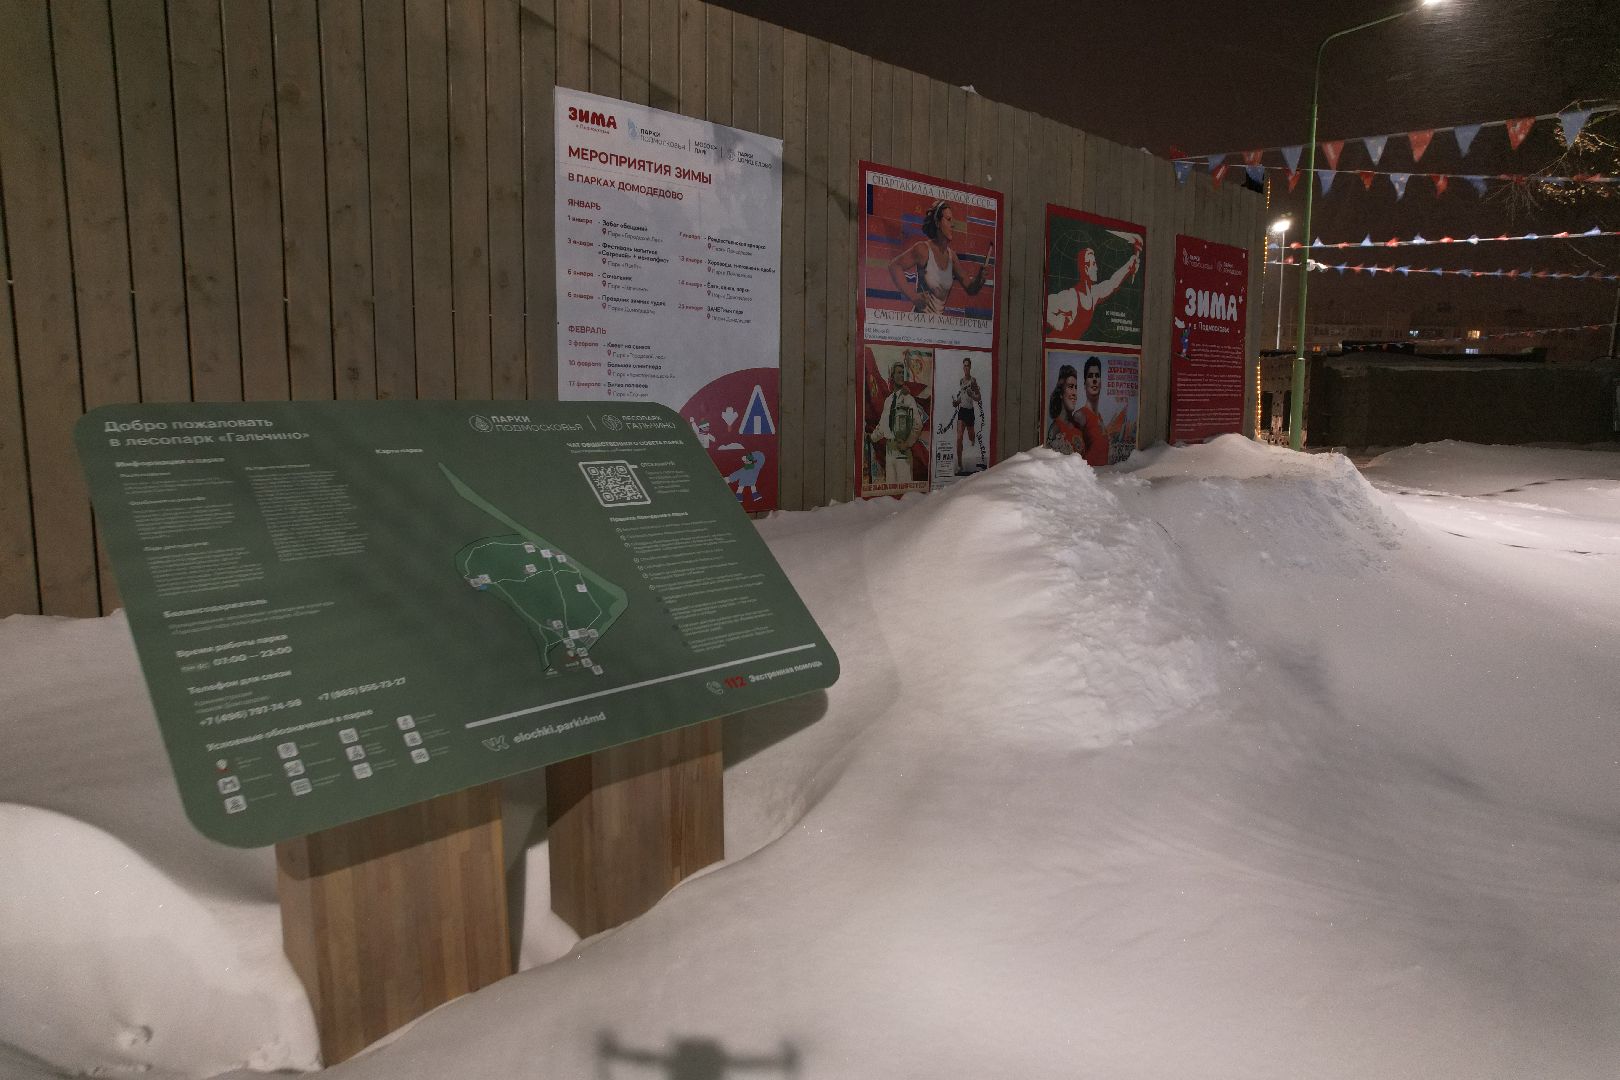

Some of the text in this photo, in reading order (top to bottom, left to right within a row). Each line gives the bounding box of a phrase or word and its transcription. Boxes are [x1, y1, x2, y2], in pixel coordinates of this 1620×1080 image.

[568, 106, 618, 130] ЗИМА
[568, 145, 713, 185] МЕРОПРИЯТИЯ ЗИМЫ
[568, 173, 684, 201] В ПАРКАХ ДОМОДЕДОВО
[568, 198, 602, 211] ЯНВАРЬ
[1184, 288, 1237, 322] ЗИМА
[568, 326, 607, 334] ФЕВРАЛЬ
[104, 419, 274, 432] Добро пожаловать
[491, 415, 531, 423] ПАРКИ
[495, 422, 584, 432] ПОДМОСКОВЬЯ
[109, 431, 310, 447] в лесопарк «Гальчино»
